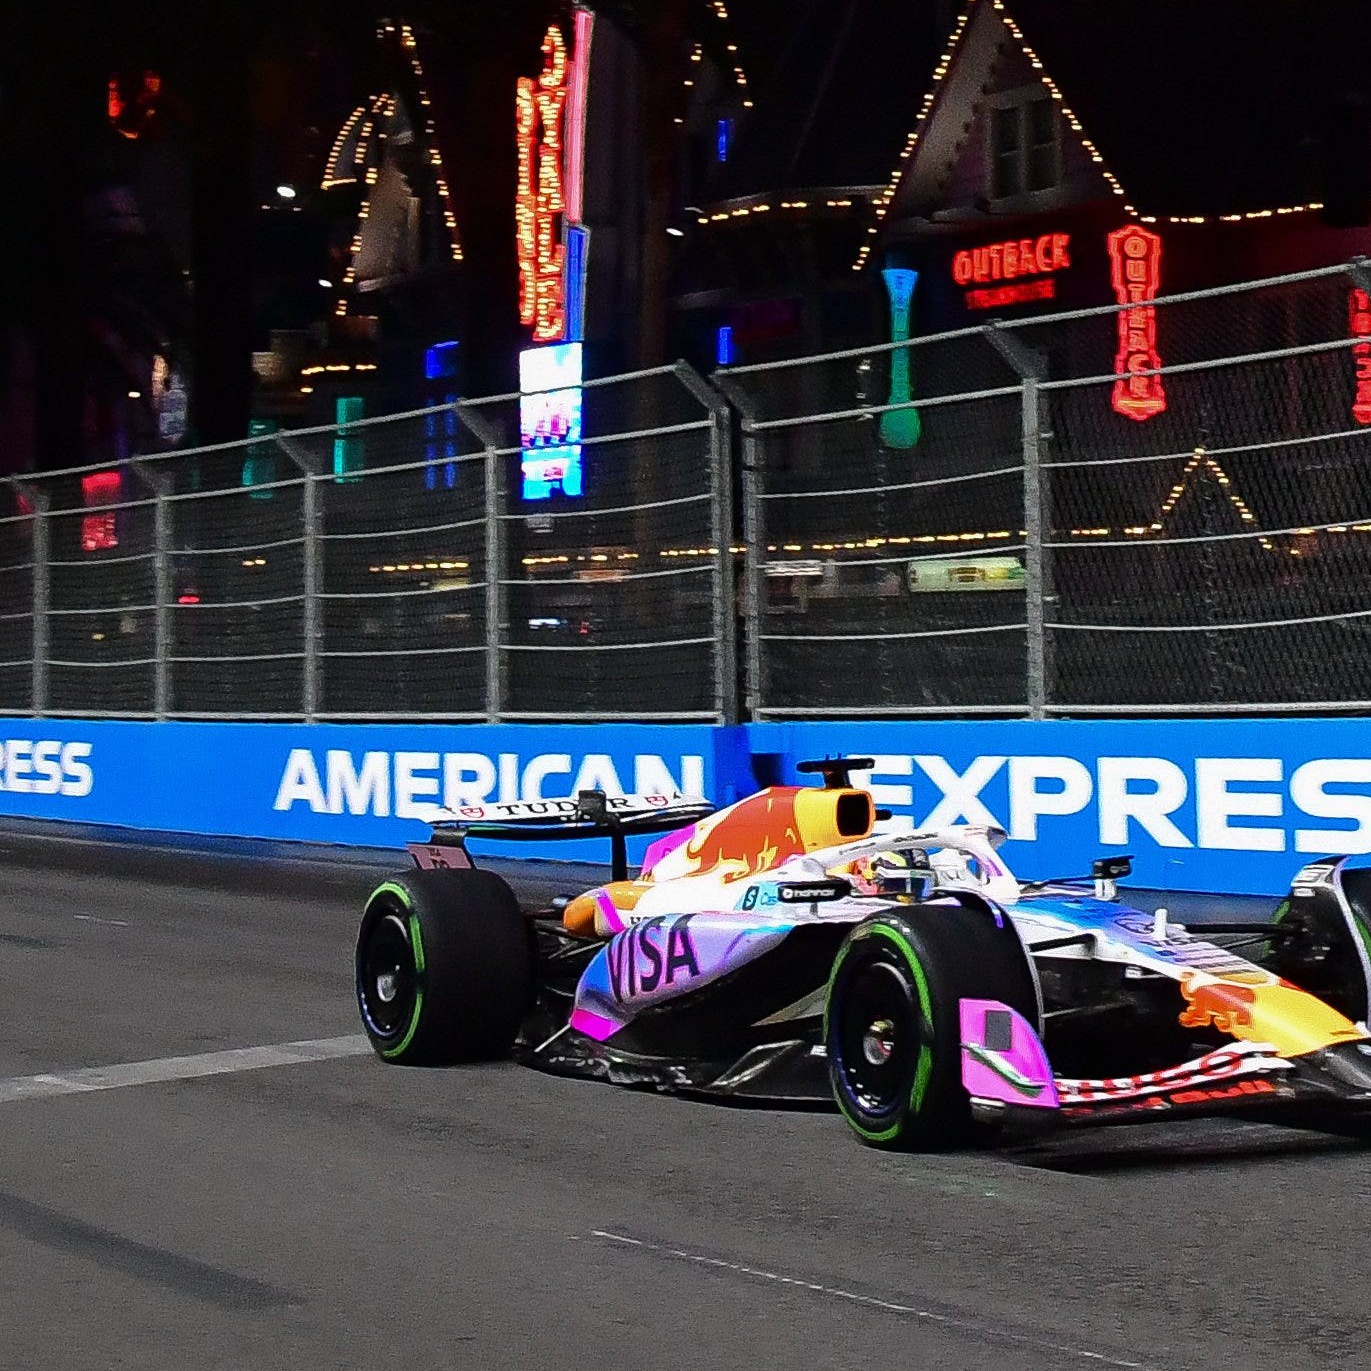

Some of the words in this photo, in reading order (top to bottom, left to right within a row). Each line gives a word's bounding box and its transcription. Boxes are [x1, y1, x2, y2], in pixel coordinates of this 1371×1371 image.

[952, 232, 1070, 285] OUTBACK
[0, 739, 93, 797] ESS
[274, 748, 701, 819] AMERICAN
[497, 796, 635, 816] TUDR
[608, 913, 702, 1003] VISA
